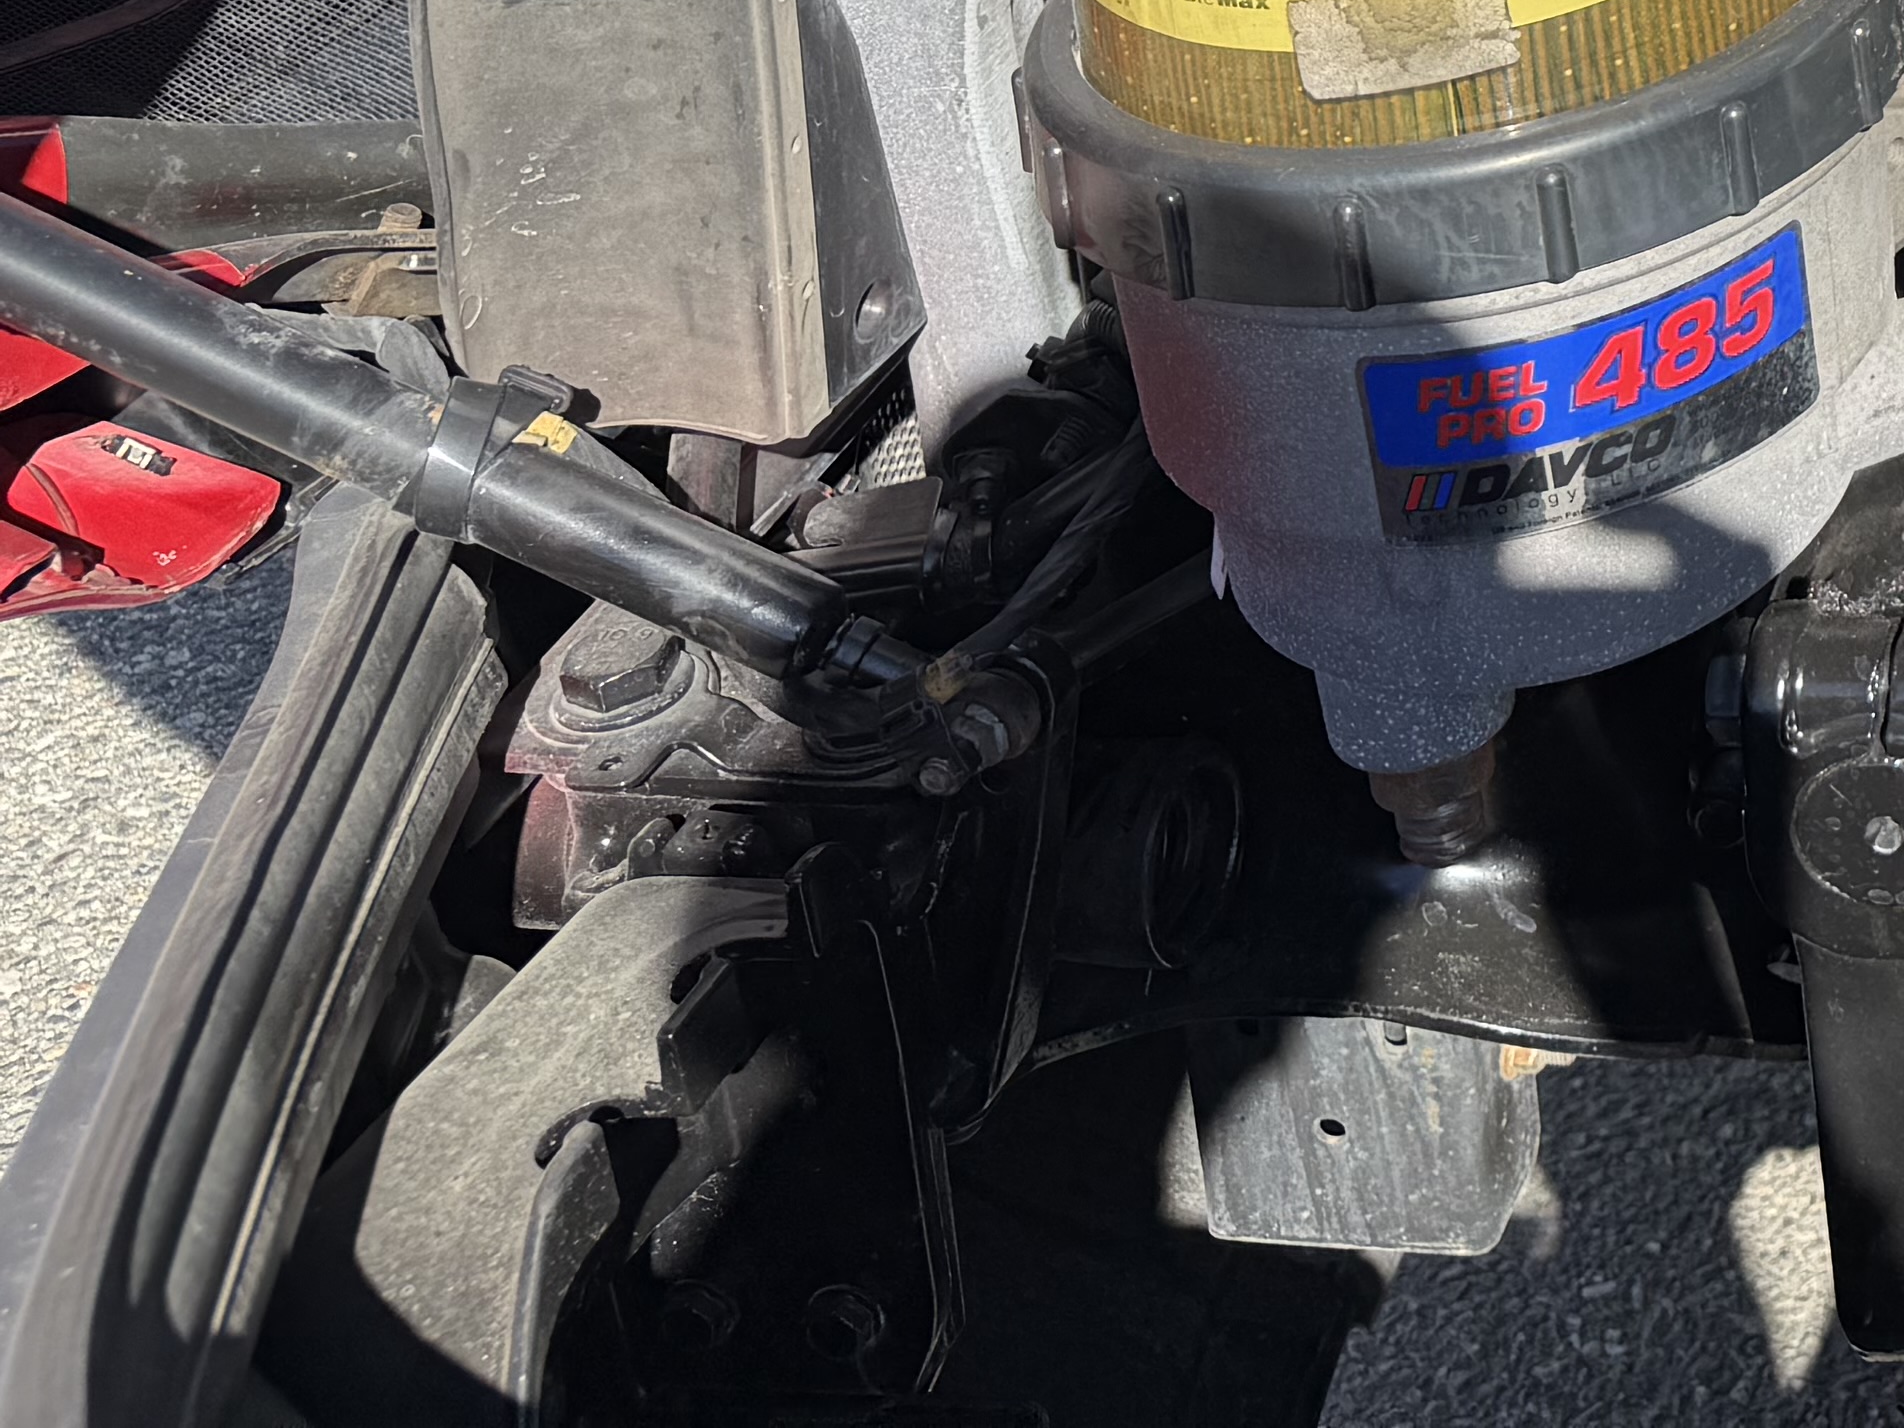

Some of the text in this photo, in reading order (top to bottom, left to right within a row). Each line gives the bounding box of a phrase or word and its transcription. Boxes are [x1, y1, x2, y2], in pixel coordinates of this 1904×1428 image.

[1417, 257, 1777, 414] FUEL 485
[1436, 398, 1547, 450] PRO
[1458, 414, 1677, 508] DAVCO
